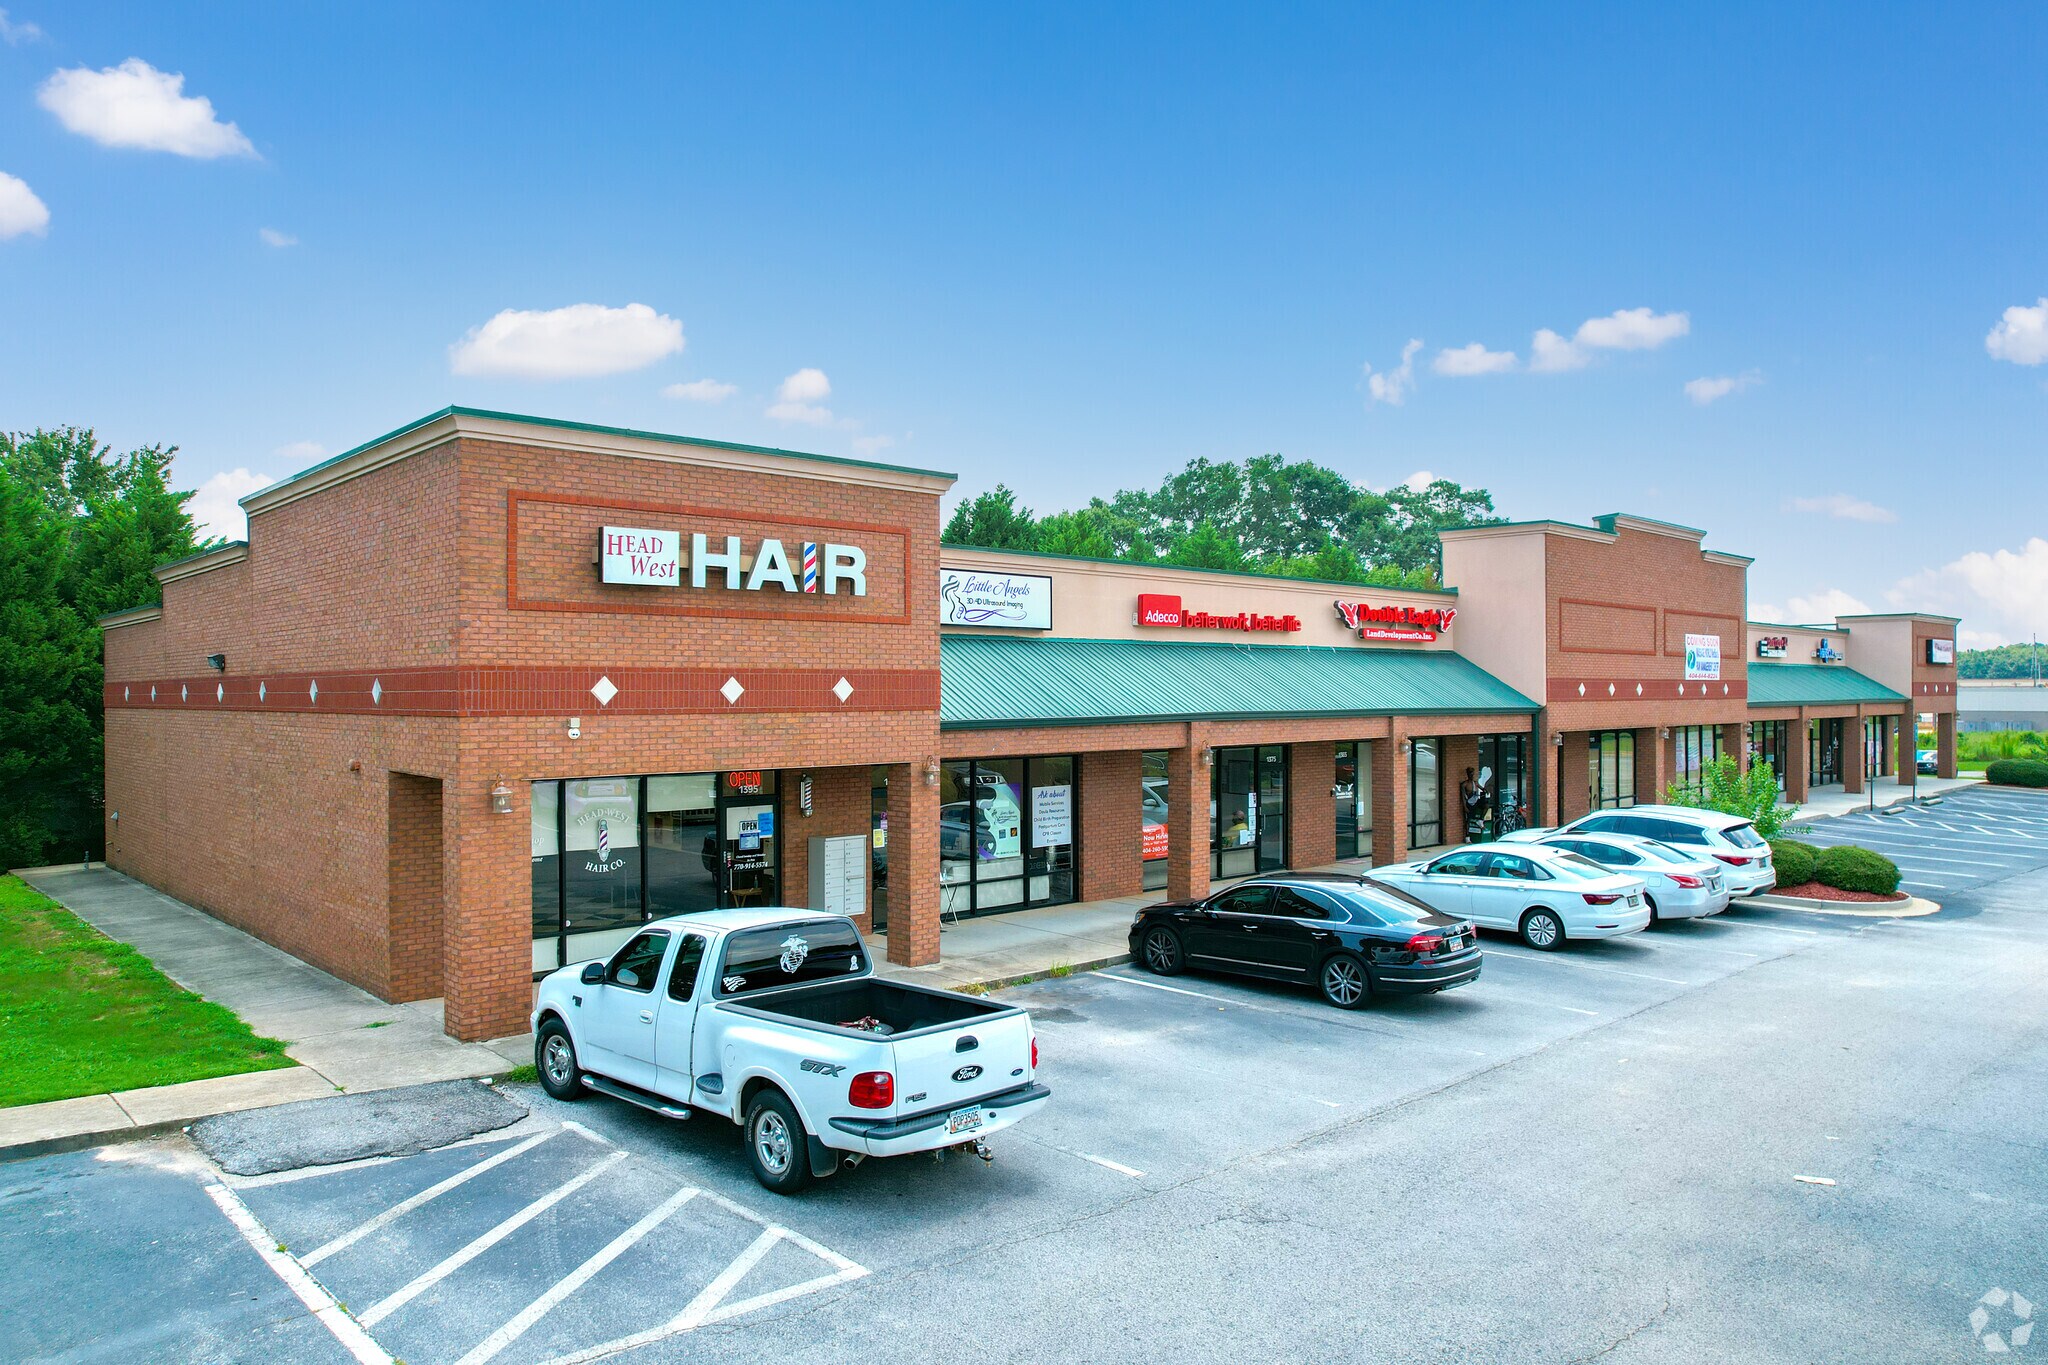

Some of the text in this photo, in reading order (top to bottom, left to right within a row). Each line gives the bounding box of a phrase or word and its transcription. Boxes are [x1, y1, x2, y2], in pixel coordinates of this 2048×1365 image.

[606, 534, 663, 556] HEAD
[630, 555, 676, 578] West
[690, 533, 867, 596] HAIR
[962, 576, 1030, 599] Little Angels
[1145, 610, 1179, 623] Adecco
[1183, 610, 1220, 628] better
[1252, 614, 1285, 631] better
[1286, 615, 1302, 632] life
[1359, 604, 1440, 628] Double Eagle
[1367, 629, 1381, 638] Land
[729, 771, 761, 787] OPEN
[739, 785, 759, 794] 1395
[1037, 789, 1066, 799] Ask about
[742, 821, 758, 831] OPEN
[585, 858, 626, 873] HAIR CO.
[800, 1058, 847, 1078] STX
[957, 1067, 979, 1081] Ford
